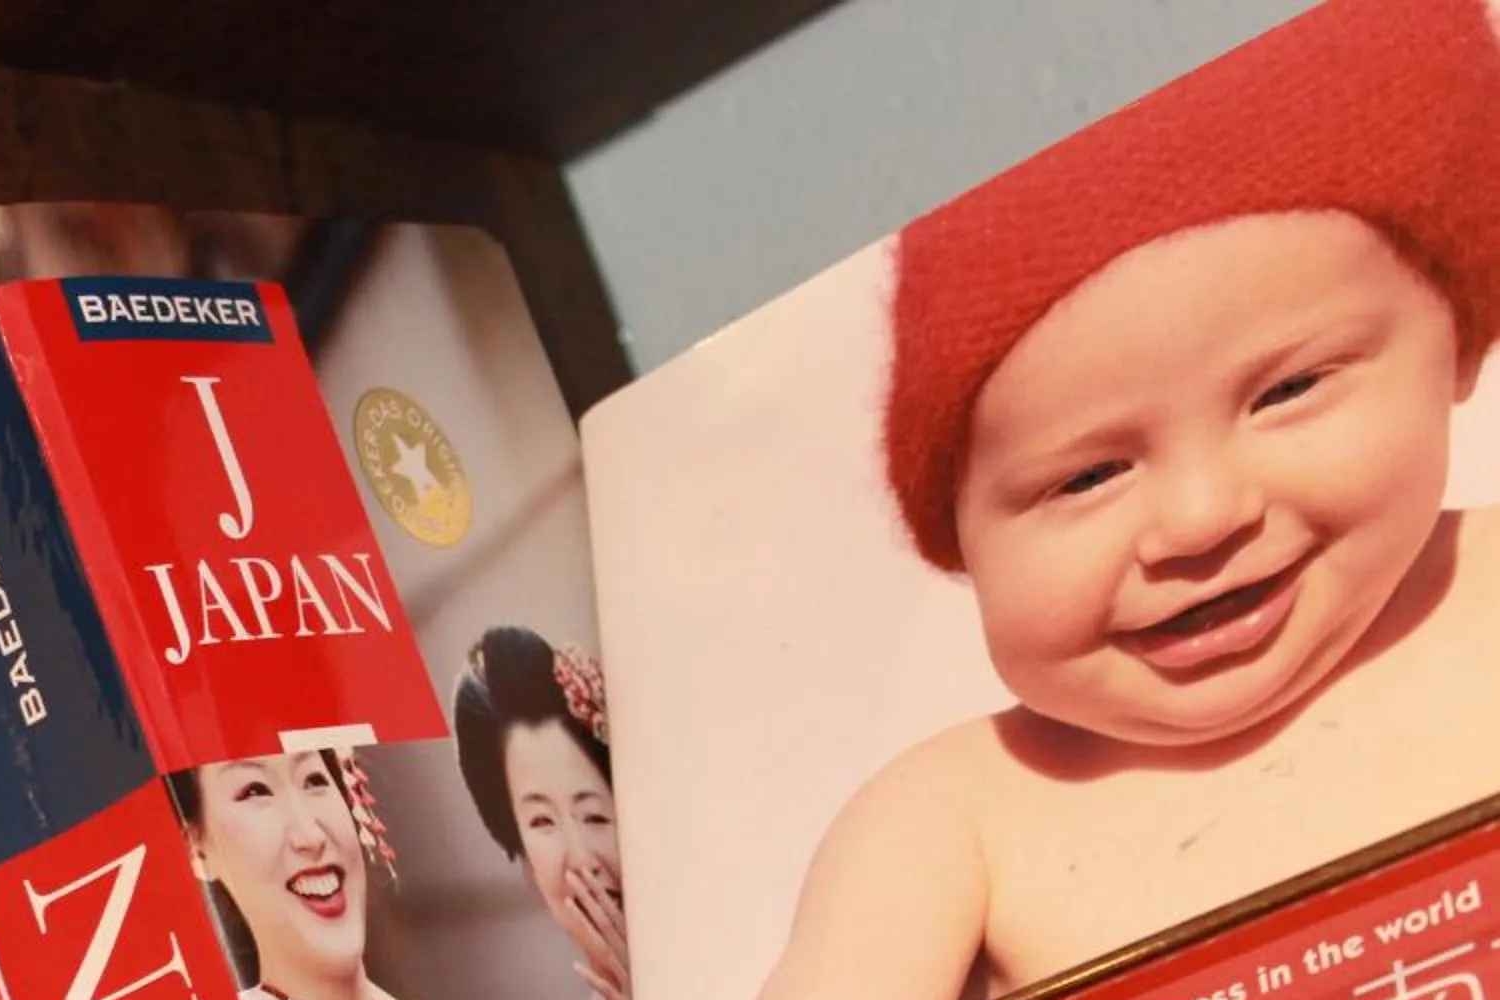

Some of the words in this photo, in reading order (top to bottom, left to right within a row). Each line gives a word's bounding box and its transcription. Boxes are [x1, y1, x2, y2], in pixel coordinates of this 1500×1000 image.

[77, 294, 262, 327] BAEDEKER
[180, 375, 255, 539] J
[144, 553, 393, 665] JAPAN
[1257, 957, 1292, 995] in
[1302, 933, 1365, 978] the
[1375, 880, 1483, 947] world
